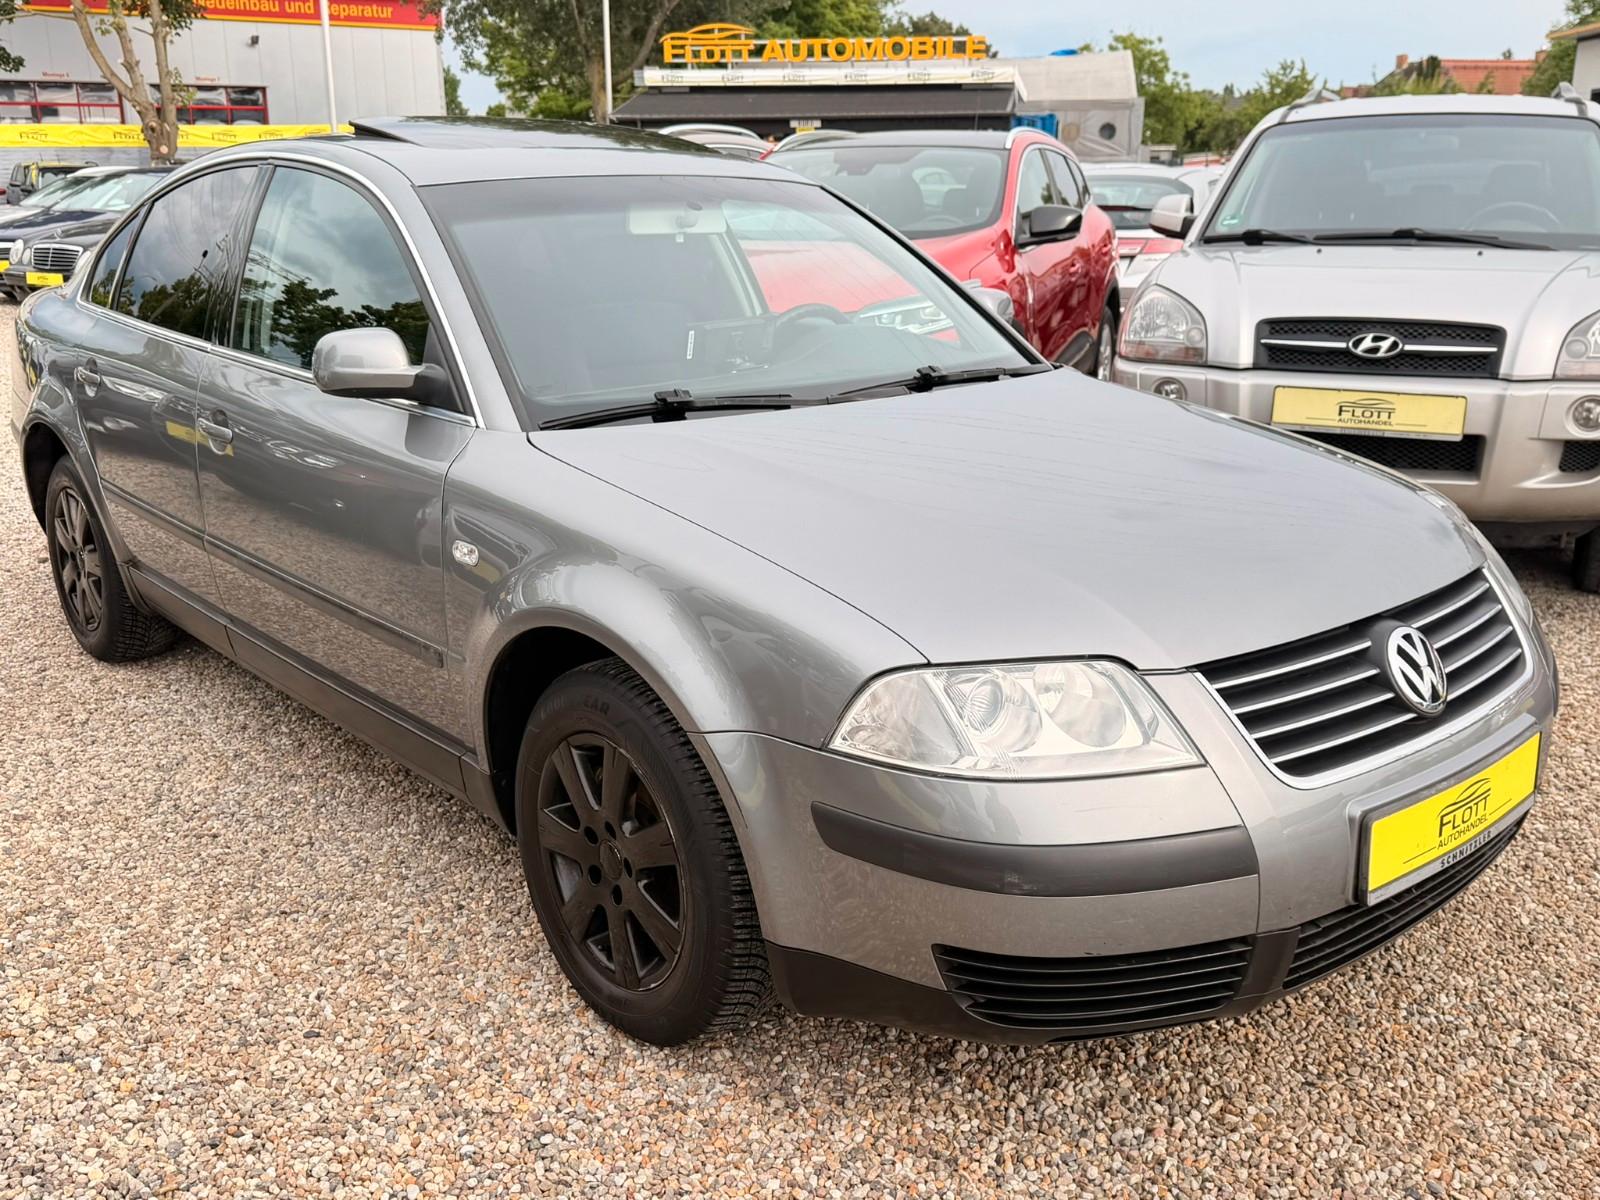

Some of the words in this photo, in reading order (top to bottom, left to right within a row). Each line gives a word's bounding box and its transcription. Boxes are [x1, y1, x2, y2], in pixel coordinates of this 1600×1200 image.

[285, 0, 314, 14] und
[323, 3, 393, 18] eparatur
[663, 39, 755, 63] FLOTT
[761, 35, 987, 62] AUTOMOBILE
[1337, 418, 1394, 427] AUTOHANDEL
[1338, 405, 1396, 420] FLOTT
[1439, 788, 1491, 838] FLOTT
[1437, 814, 1488, 850] AUTOHANDEL
[1440, 830, 1492, 868] SCHNITZLER
